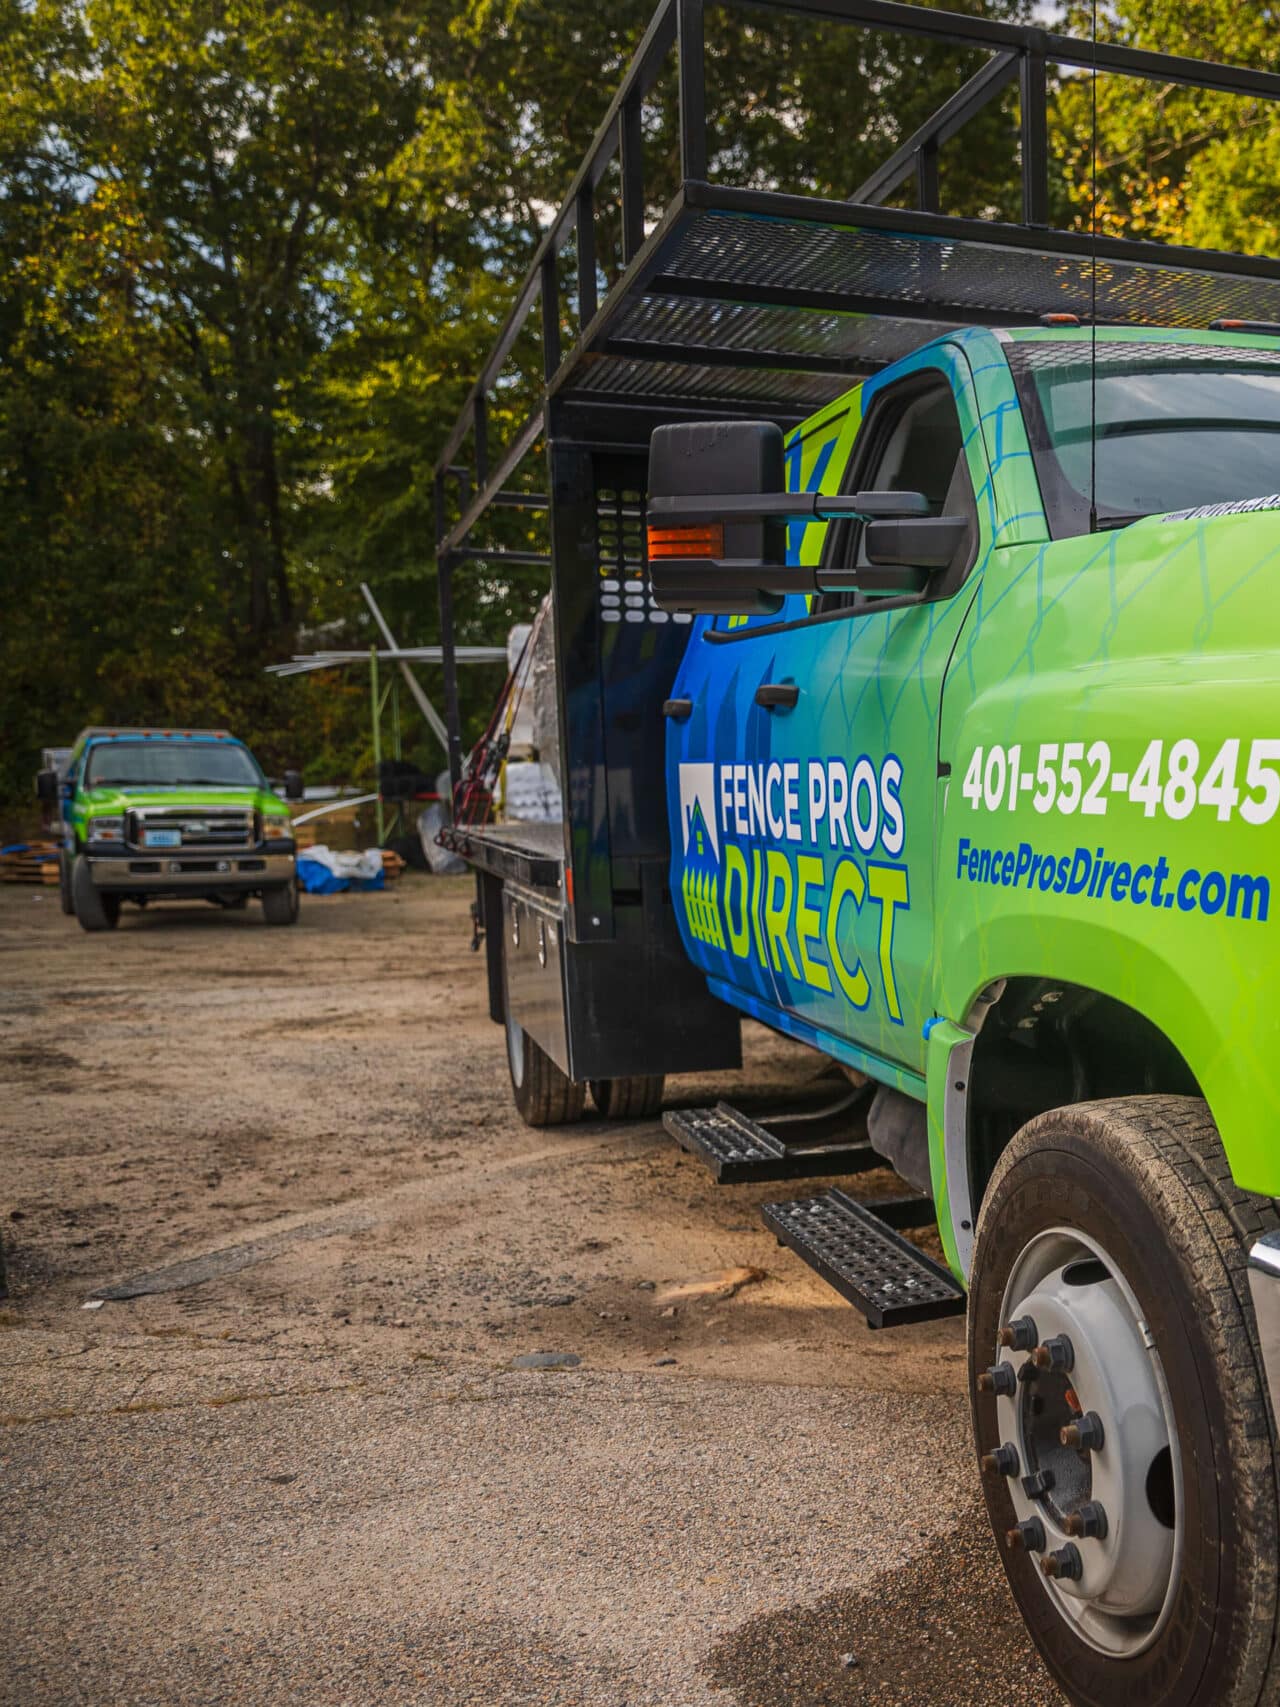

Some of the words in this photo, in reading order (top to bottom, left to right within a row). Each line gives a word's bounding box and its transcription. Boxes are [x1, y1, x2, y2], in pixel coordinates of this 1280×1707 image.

[720, 760, 803, 842] FENCE
[808, 757, 905, 854] PROS
[957, 838, 1271, 922] FenceProsDirect.com
[724, 848, 909, 1021] DIRECT
